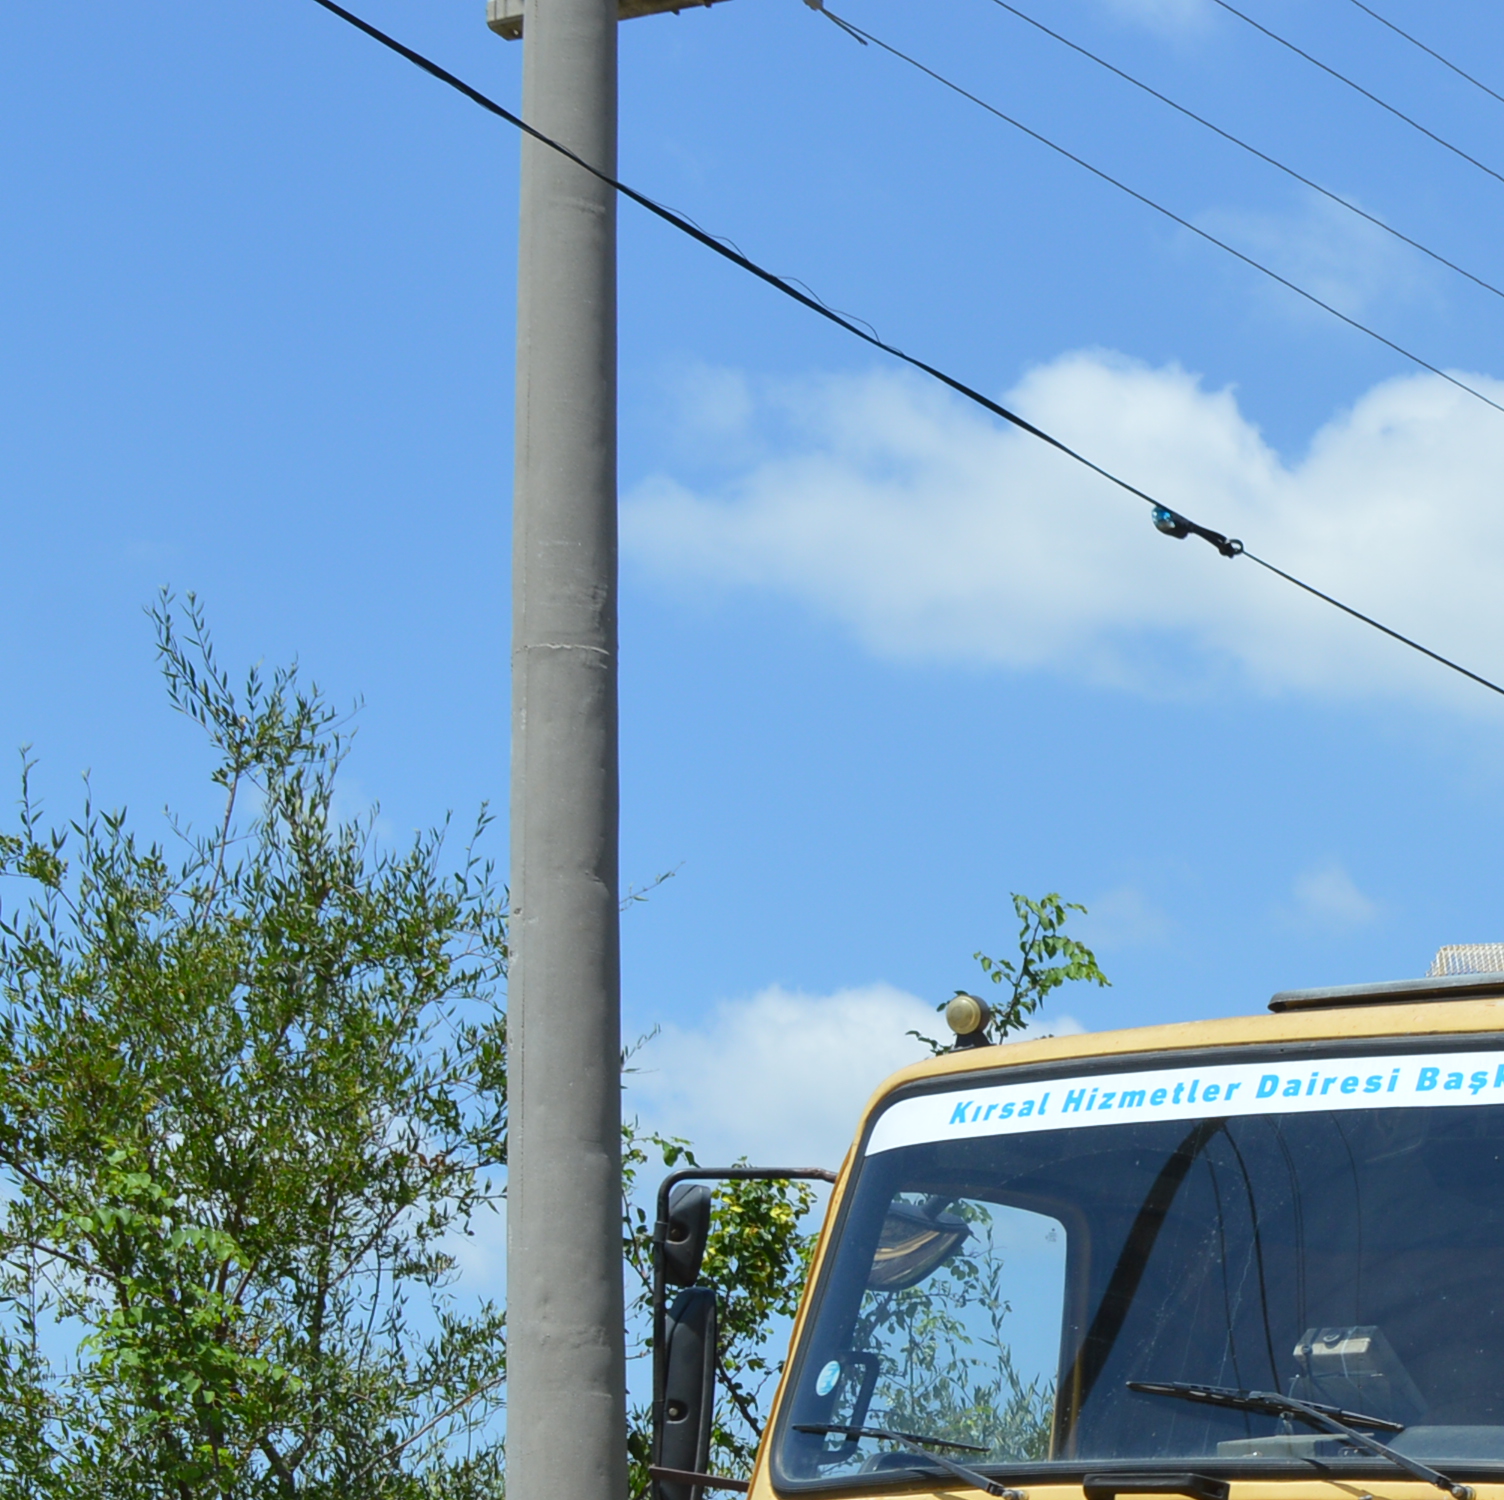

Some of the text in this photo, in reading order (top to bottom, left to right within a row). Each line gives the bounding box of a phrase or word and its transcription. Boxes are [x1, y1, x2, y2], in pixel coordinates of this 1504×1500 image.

[949, 1092, 1051, 1125] Kırsal
[1061, 1079, 1242, 1114] Hizmetler
[1255, 1068, 1401, 1099] Dairesi
